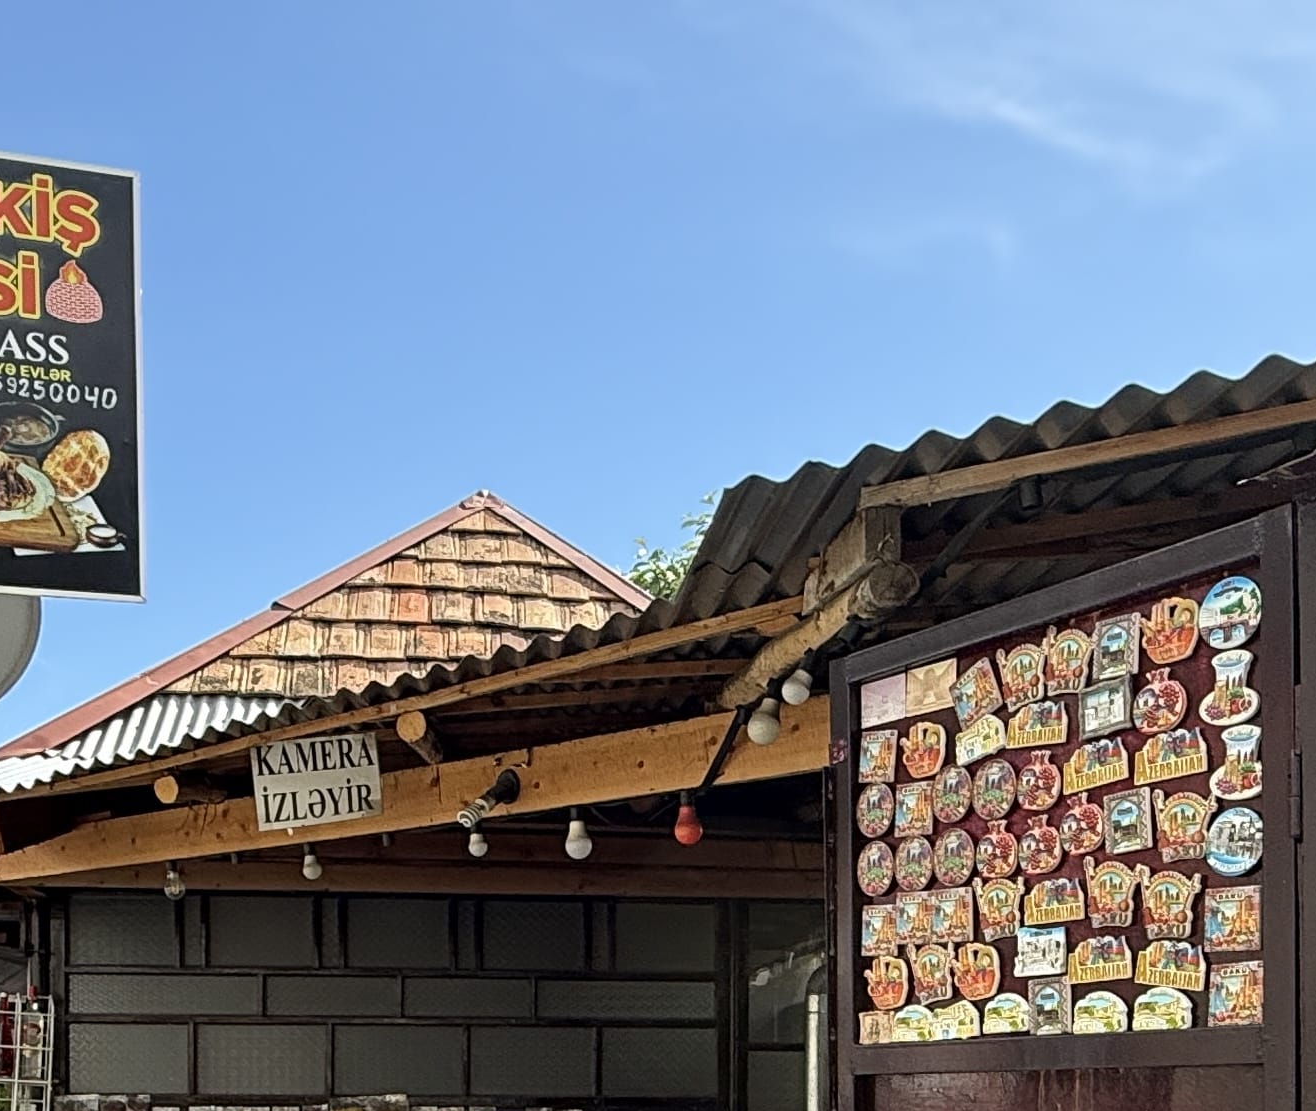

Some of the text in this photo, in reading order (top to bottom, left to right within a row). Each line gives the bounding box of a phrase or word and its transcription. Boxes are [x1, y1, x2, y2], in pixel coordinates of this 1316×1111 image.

[20, 363, 72, 382] EVLƏR
[255, 737, 375, 776] KAMERA
[261, 777, 375, 823] İZLƏYİR
[1223, 967, 1248, 975] BAKU
